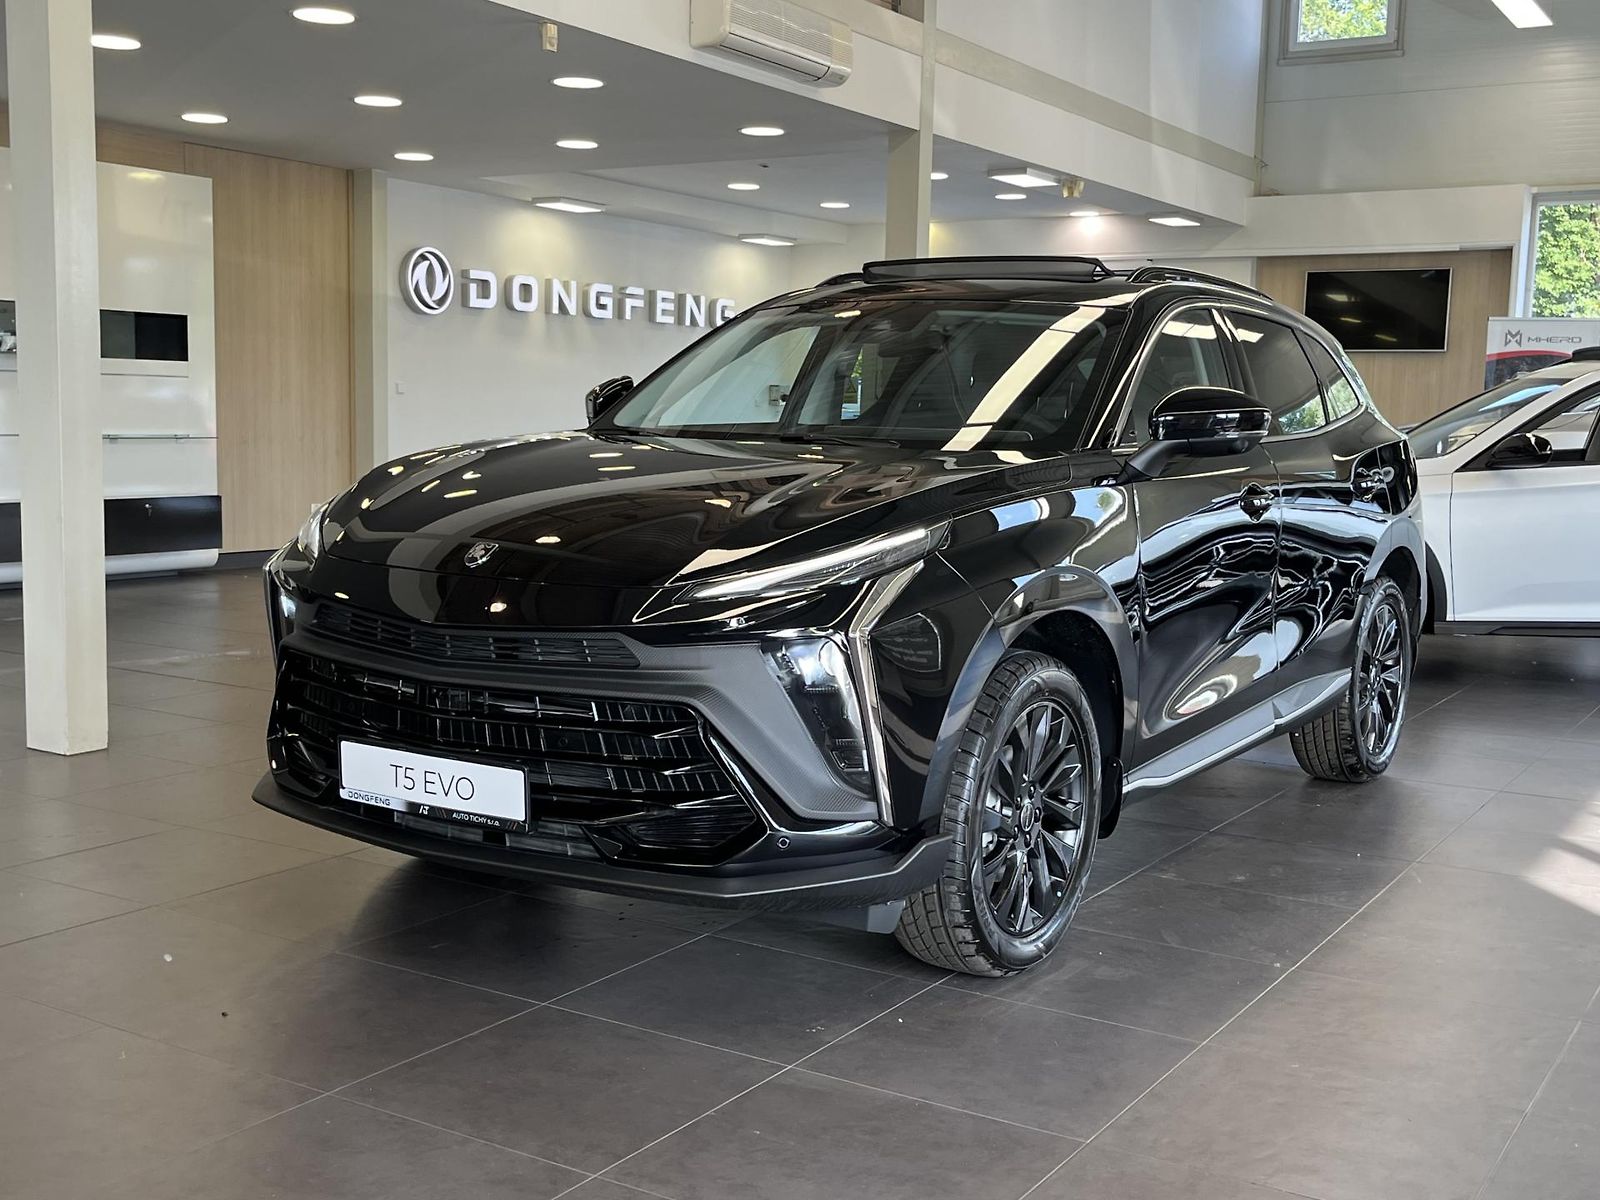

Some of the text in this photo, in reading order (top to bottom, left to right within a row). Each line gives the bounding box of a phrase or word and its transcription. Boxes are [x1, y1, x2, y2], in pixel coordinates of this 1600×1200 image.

[461, 268, 736, 328] DONGFENG
[390, 763, 475, 801] T5 EVO
[347, 790, 391, 806] DONGFENG
[452, 811, 470, 821] AUTO
